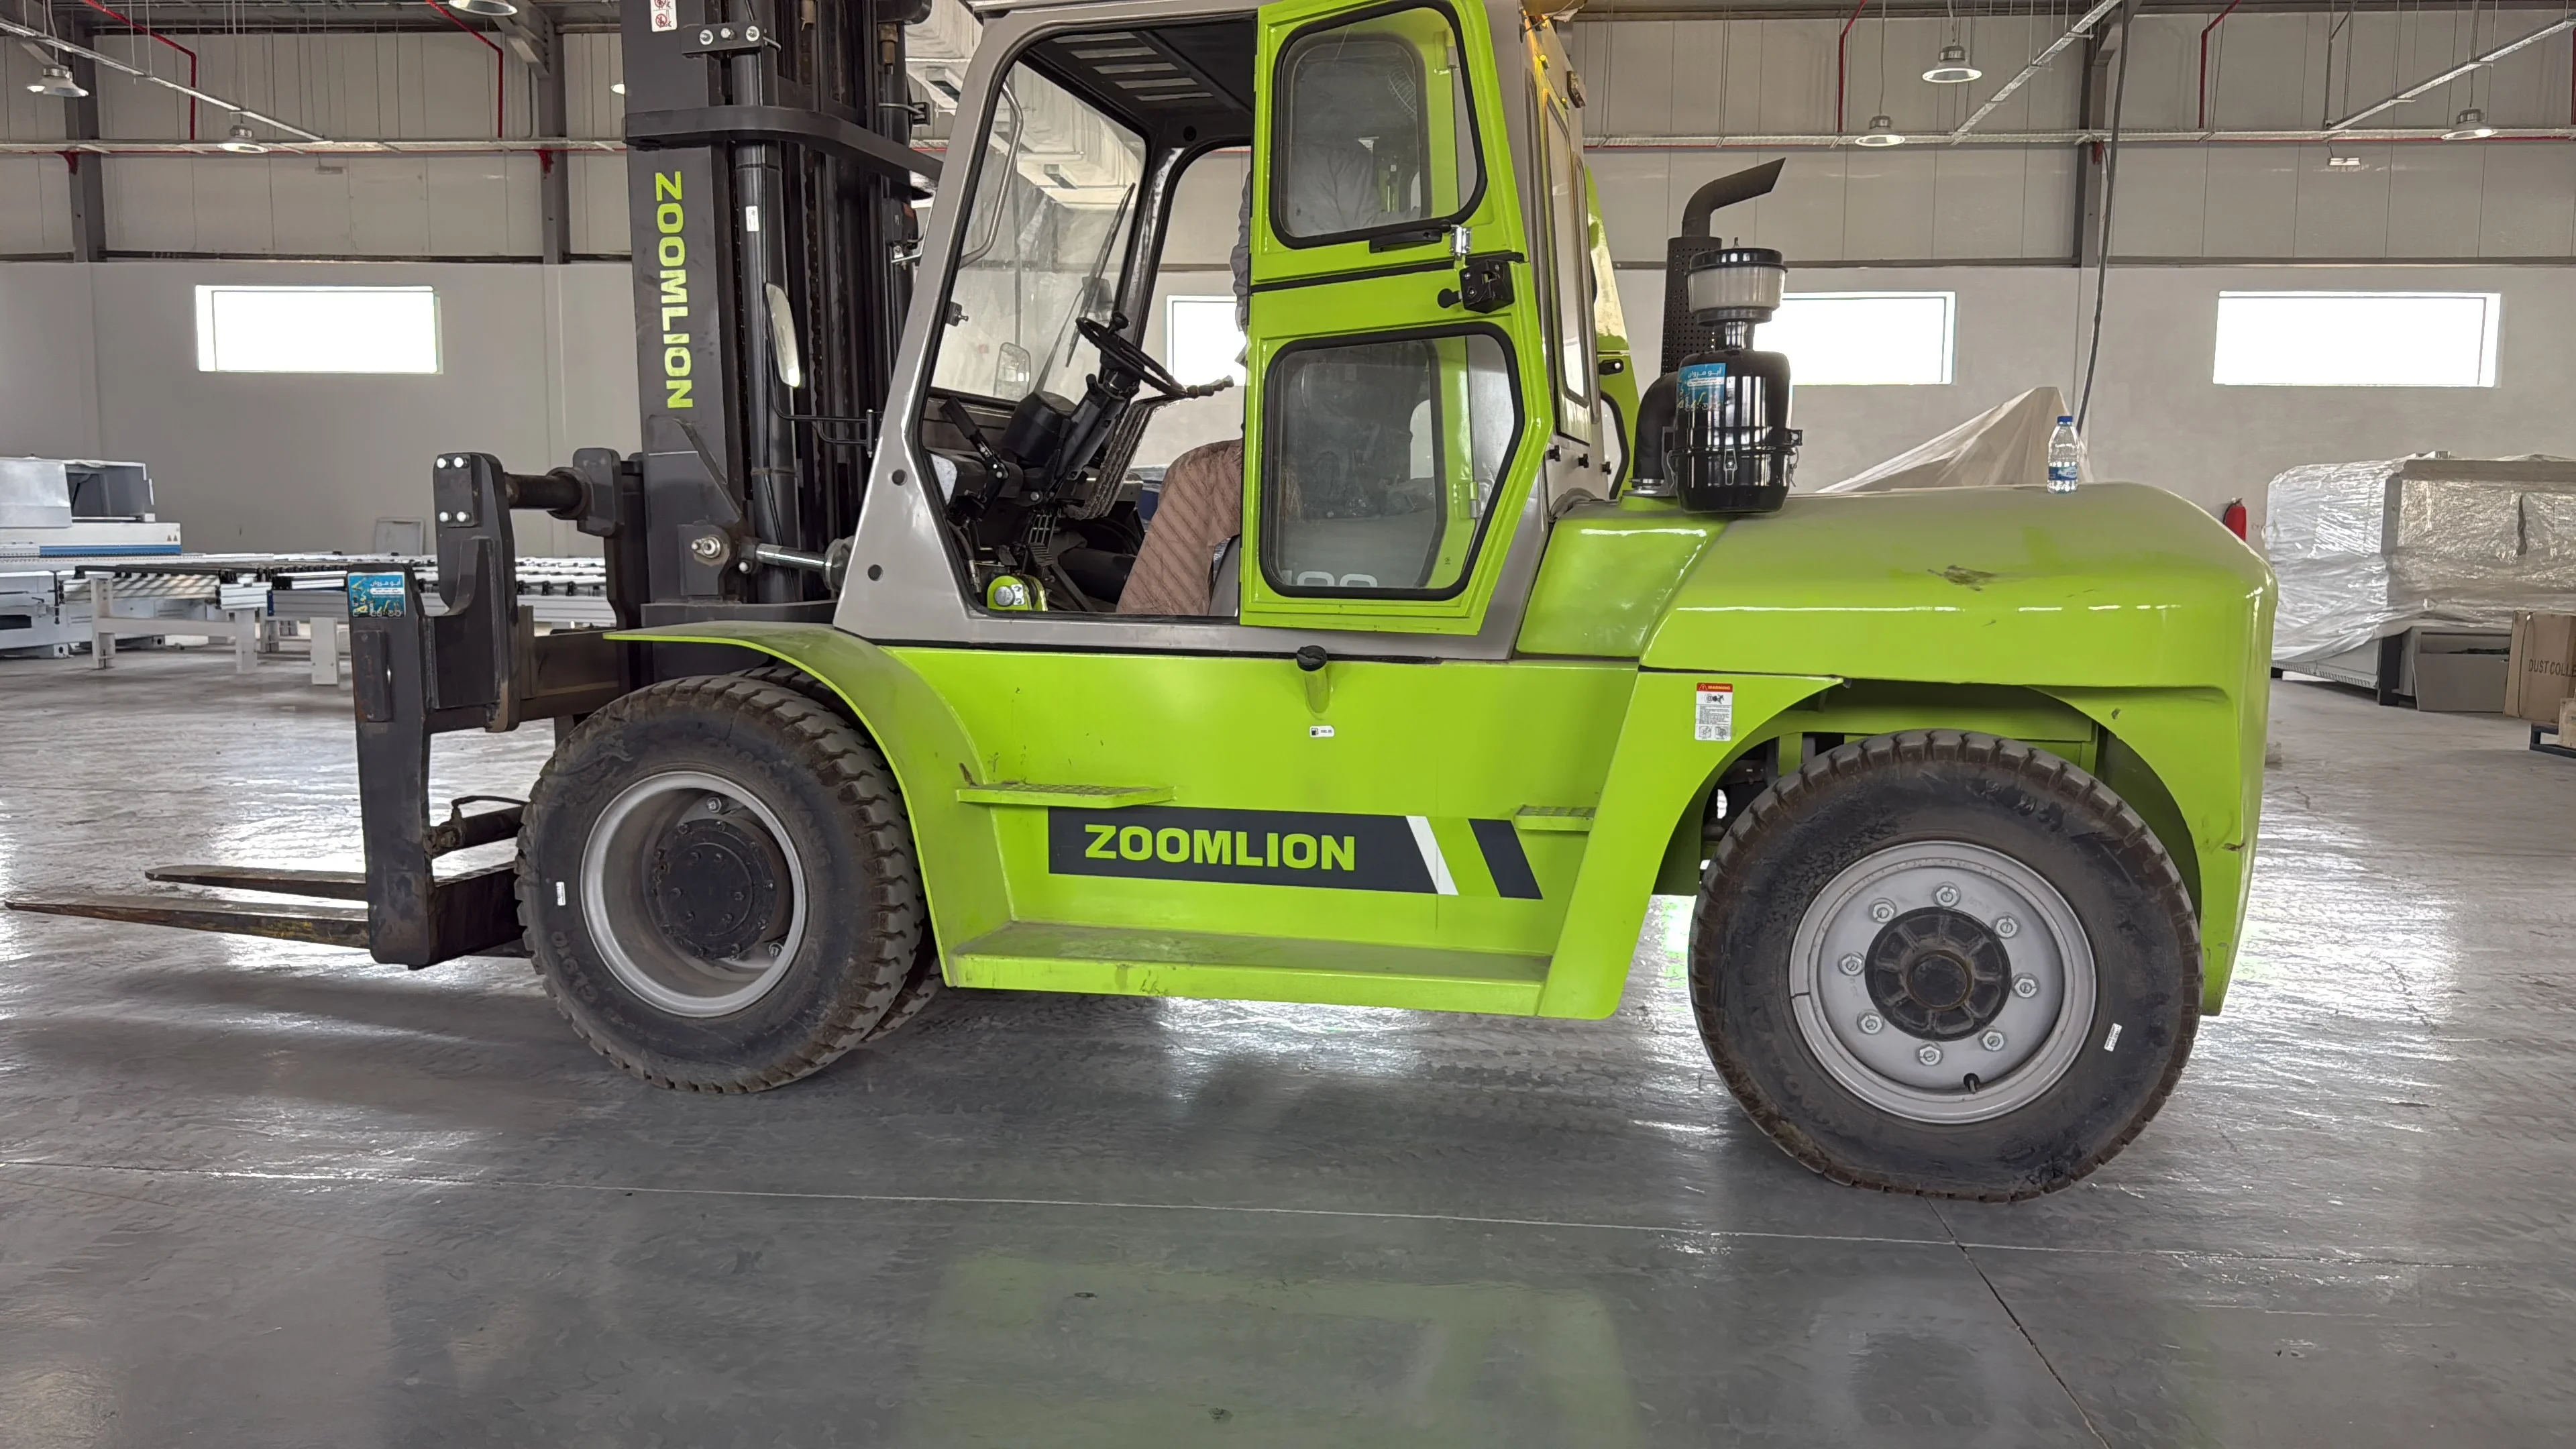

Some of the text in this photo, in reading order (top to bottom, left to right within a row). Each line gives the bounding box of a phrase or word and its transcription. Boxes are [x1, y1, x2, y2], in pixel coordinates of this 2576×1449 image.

[655, 171, 693, 409] ZOOMLION
[1707, 366, 1721, 376] أبو
[389, 578, 400, 587] أبو
[2528, 659, 2549, 674] DUST
[1085, 824, 1355, 871] ZOOMLION
